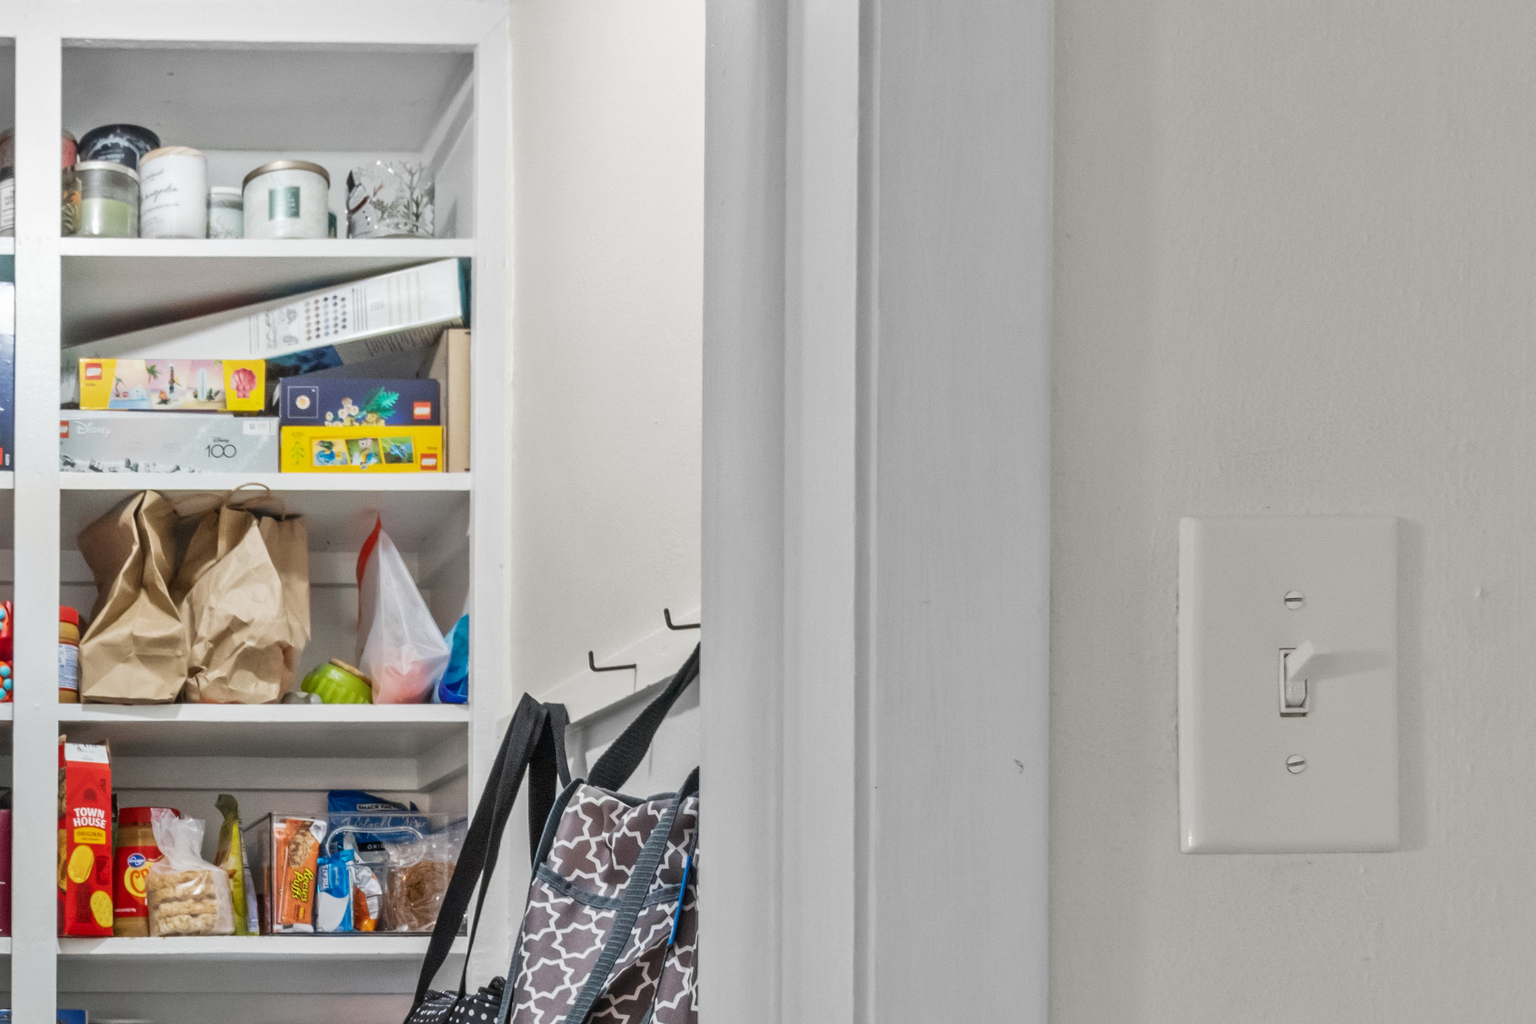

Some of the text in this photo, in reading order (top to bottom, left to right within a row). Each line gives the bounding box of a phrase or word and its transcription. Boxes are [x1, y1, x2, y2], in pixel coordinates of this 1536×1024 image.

[74, 421, 112, 437] Disney
[205, 443, 237, 458] 100
[73, 807, 105, 819] TOWN
[73, 817, 107, 829] HOUSE
[291, 870, 304, 900] Puffs
